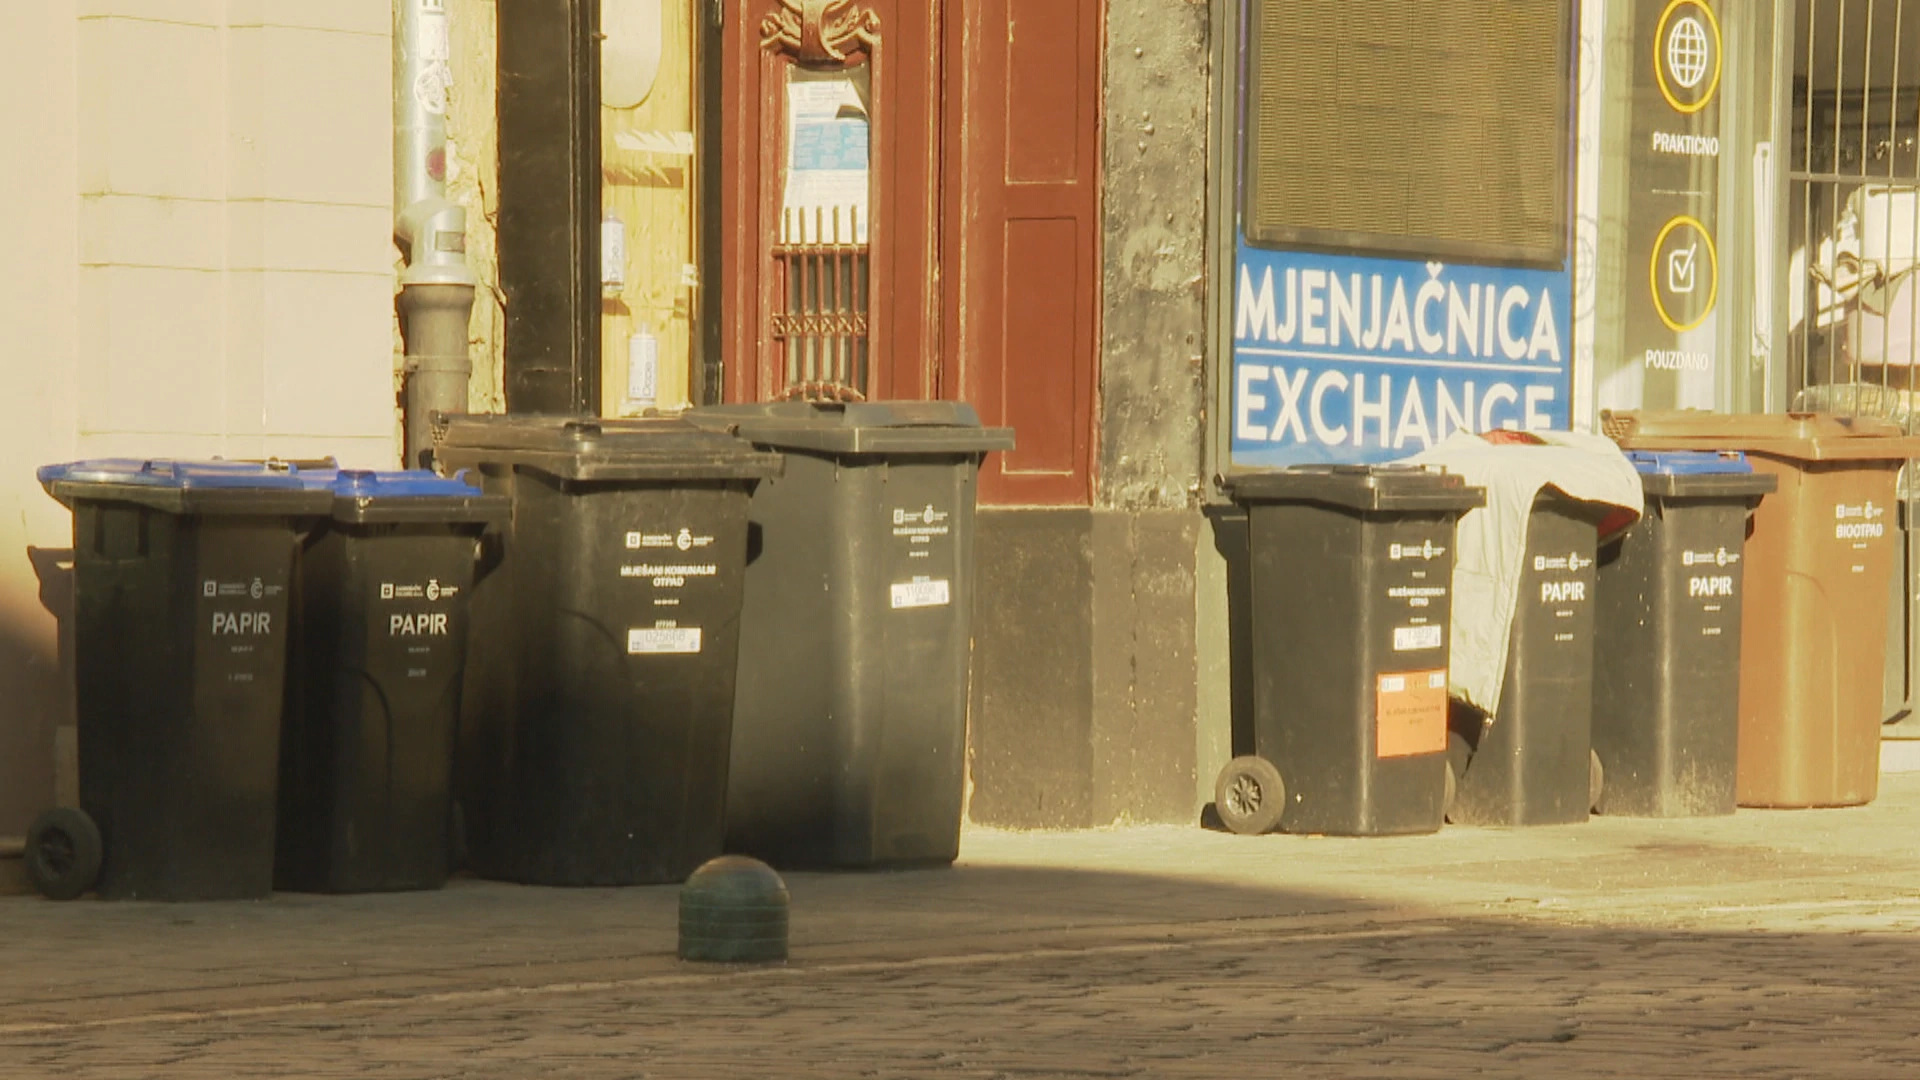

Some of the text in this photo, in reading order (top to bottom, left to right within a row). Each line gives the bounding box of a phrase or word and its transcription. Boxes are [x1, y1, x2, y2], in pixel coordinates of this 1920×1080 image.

[1652, 131, 1719, 156] PRAKTIČNO
[1235, 261, 1560, 362] MJENJAČNICA
[1645, 349, 1709, 371] POUZDANO
[1237, 364, 1555, 449] EXCHANGE
[1835, 523, 1883, 538] BIOOTPAD
[652, 576, 685, 587] OTPAD
[1541, 581, 1585, 602] PAPIR
[1689, 576, 1733, 597] PAPIR
[211, 612, 271, 635] PAPIR
[389, 613, 448, 636] PAPIR
